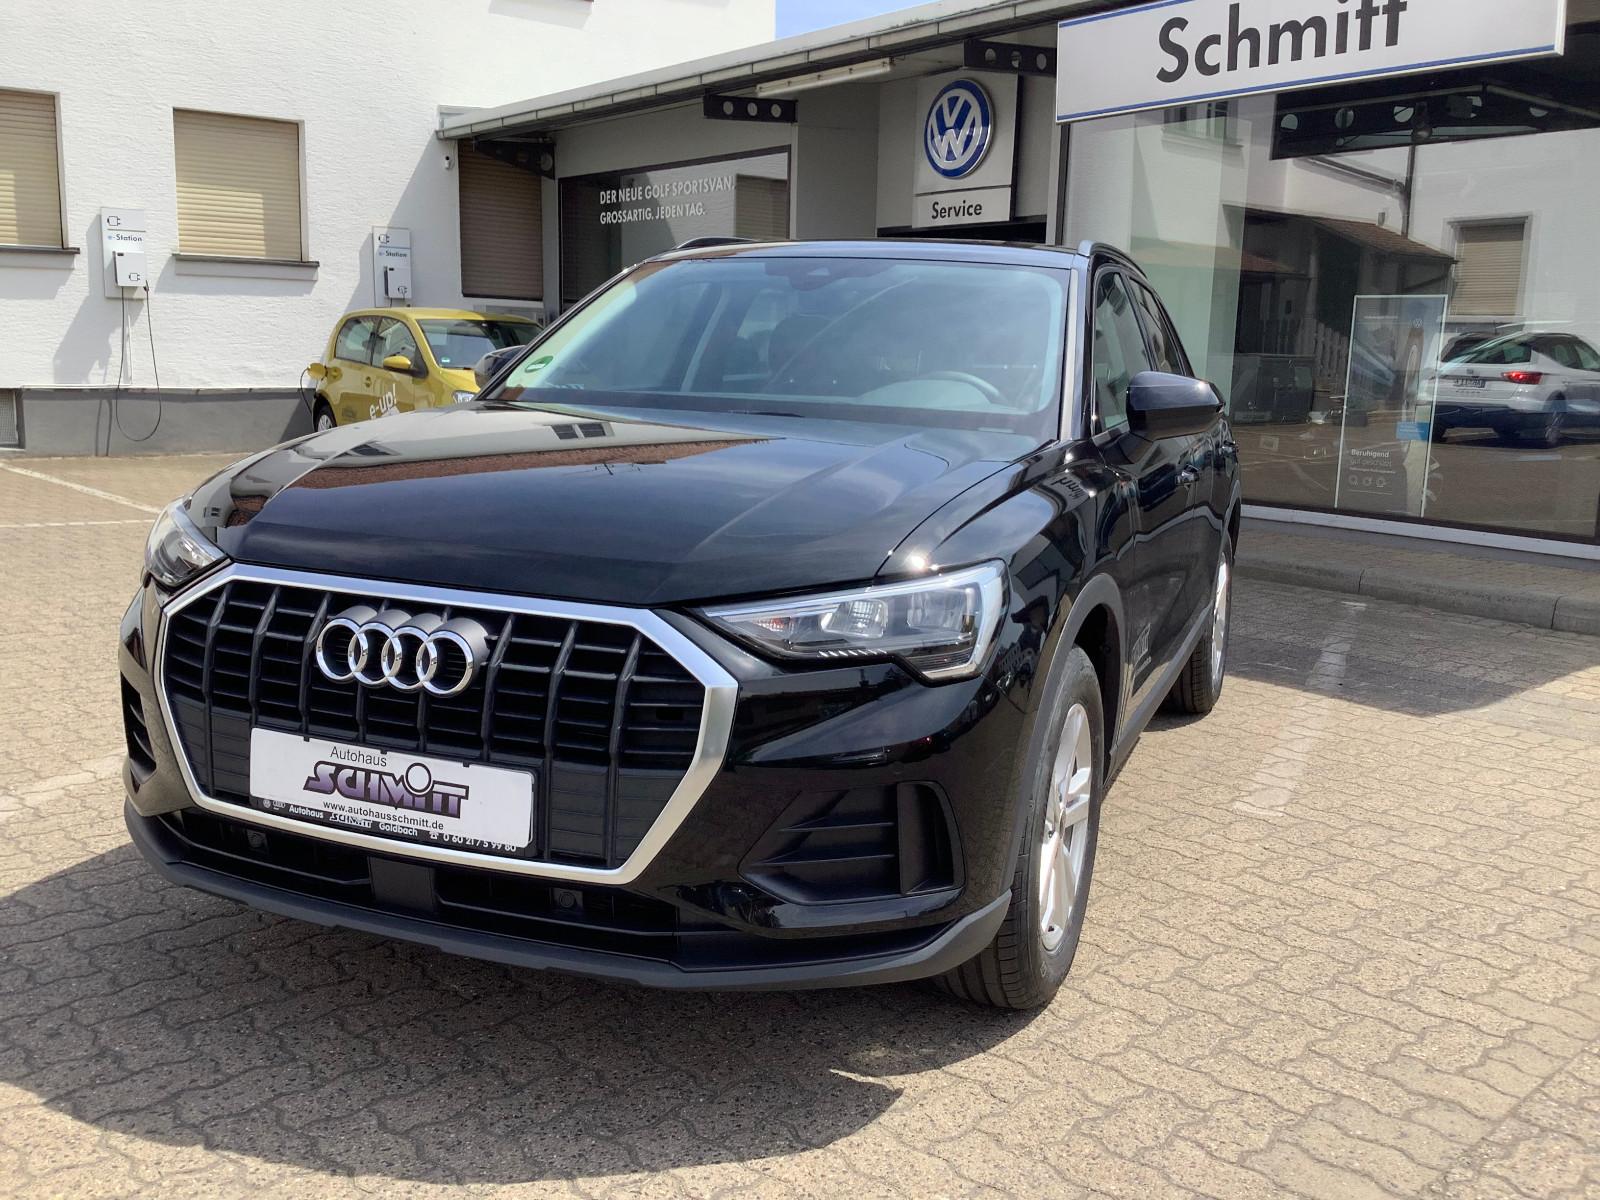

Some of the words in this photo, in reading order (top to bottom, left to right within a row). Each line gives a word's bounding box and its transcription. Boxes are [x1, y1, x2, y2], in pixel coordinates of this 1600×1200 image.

[1156, 0, 1407, 84] Schmitt
[600, 190, 617, 205] DER
[618, 186, 643, 203] NEUE
[644, 183, 670, 200] GOLF
[672, 175, 735, 197] SPORTSVAN.
[600, 206, 654, 225] GROSSARTIG.
[655, 205, 683, 220] JEDEN
[685, 201, 706, 217] TAG.
[931, 199, 983, 220] Service
[370, 383, 397, 420] e-up!
[330, 745, 388, 767] Autohaus
[289, 804, 324, 819] Autohaus
[379, 822, 418, 837] Goldbach
[323, 802, 444, 831] www.autohausschmitt.de
